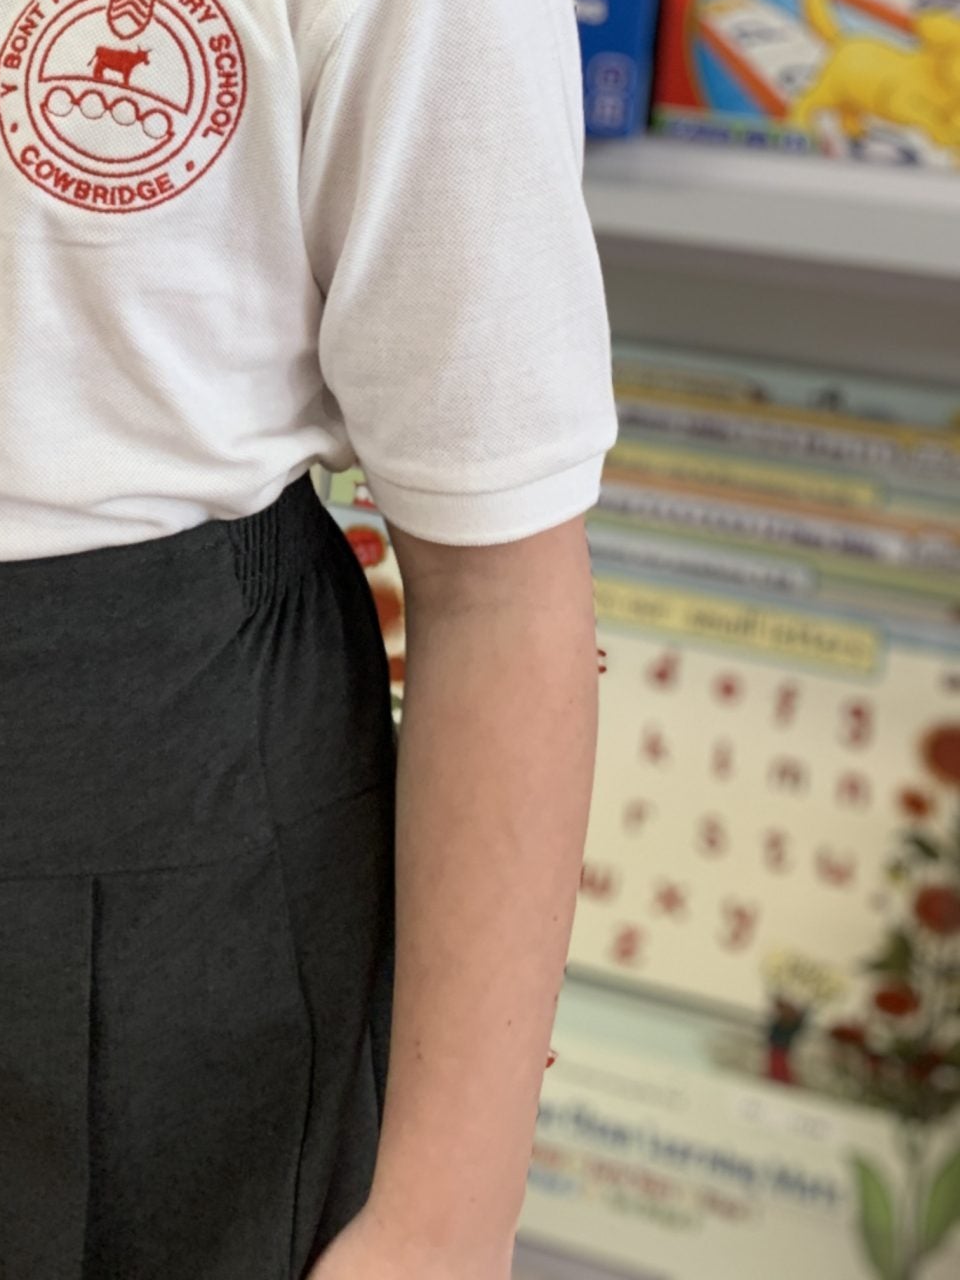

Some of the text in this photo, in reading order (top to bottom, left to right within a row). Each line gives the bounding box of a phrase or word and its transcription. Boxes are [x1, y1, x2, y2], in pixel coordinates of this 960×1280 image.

[3, 3, 46, 70] BONT
[0, 83, 18, 98] Y
[202, 34, 239, 139] SCHOOL
[20, 145, 175, 206] COWBRIDGE
